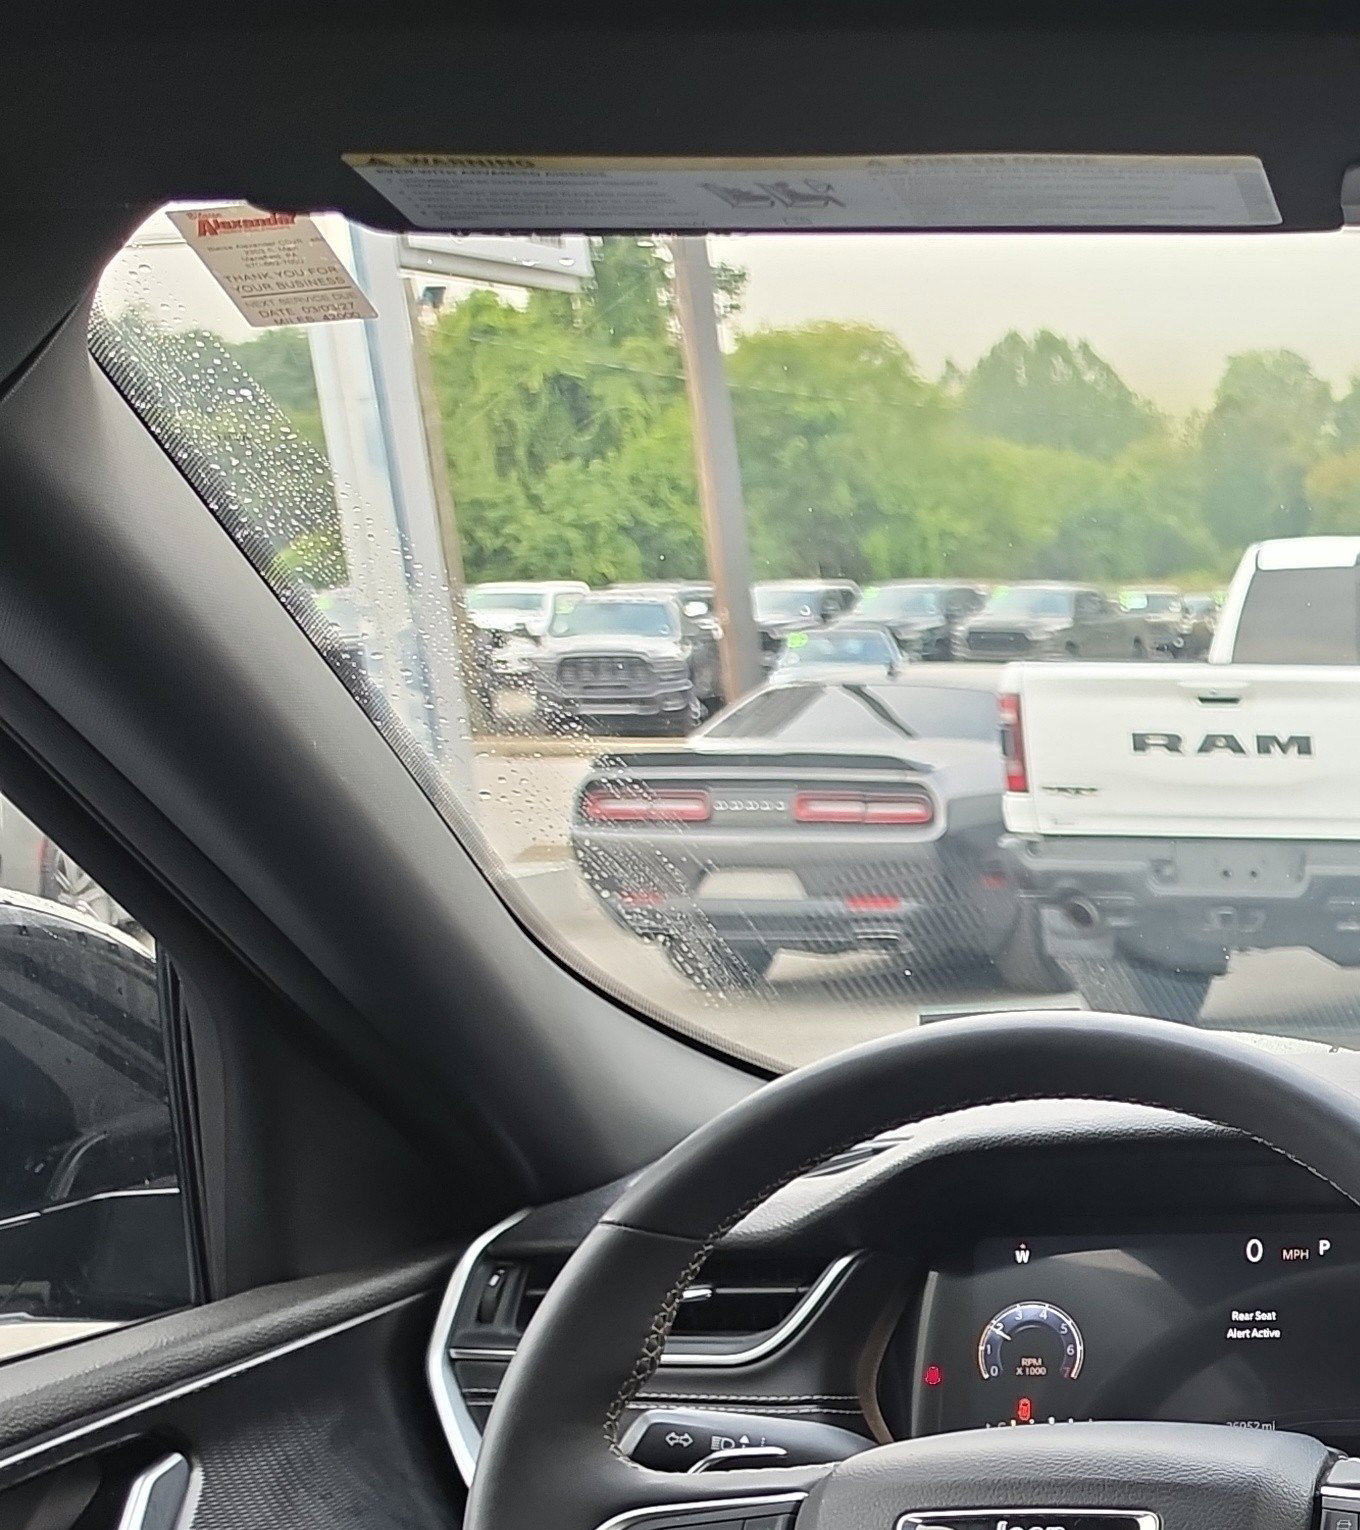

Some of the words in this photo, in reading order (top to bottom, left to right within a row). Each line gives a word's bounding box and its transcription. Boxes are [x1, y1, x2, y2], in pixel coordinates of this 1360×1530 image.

[404, 156, 536, 168] WARNING
[224, 271, 273, 283] THANK
[275, 269, 305, 278] YOU
[307, 266, 338, 275] FOR
[234, 283, 273, 293] YOUR
[276, 277, 346, 290] BUSINESS
[259, 306, 296, 318] DATE
[274, 315, 315, 325] MILES
[1131, 732, 1313, 755] RAM
[1246, 1238, 1263, 1262] 0
[1282, 1249, 1310, 1260] MPH
[1319, 1239, 1331, 1255] P
[1015, 1249, 1030, 1263] W
[1231, 1310, 1255, 1321] Rear
[1255, 1310, 1277, 1321] Seat
[1226, 1328, 1250, 1339] Alert
[1251, 1328, 1281, 1338] Active
[1066, 1344, 1075, 1356] 6
[1021, 1358, 1043, 1366] RPM
[990, 1365, 999, 1377] 0
[1025, 1367, 1047, 1376] 1000
